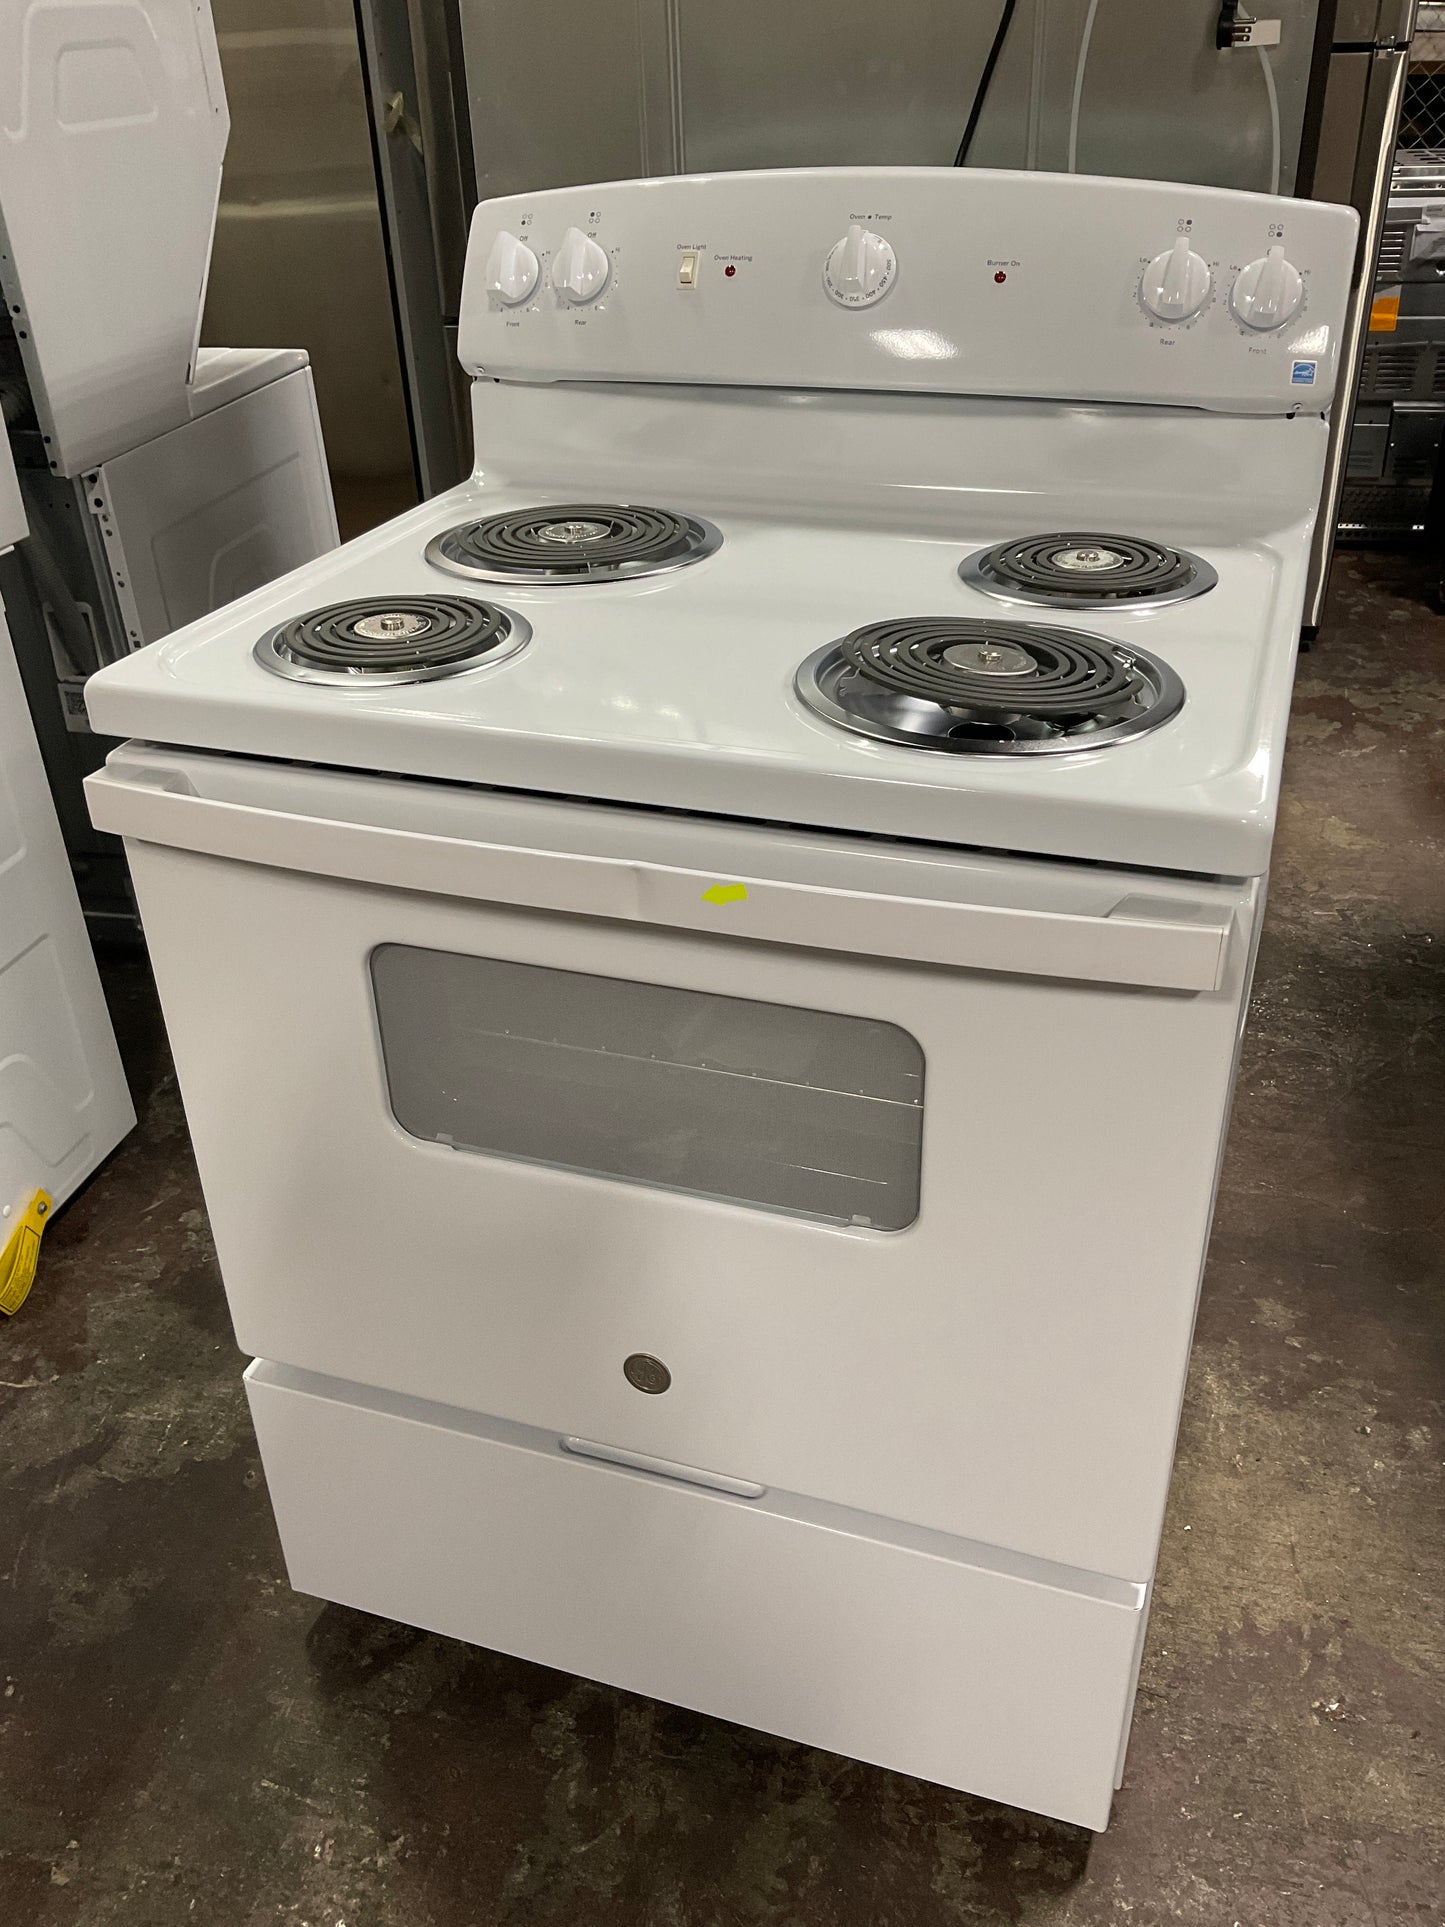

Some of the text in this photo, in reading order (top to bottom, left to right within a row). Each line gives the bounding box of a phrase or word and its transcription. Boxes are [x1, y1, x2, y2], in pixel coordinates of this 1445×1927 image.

[875, 213, 893, 221] Temp
[519, 234, 529, 243] Off
[587, 231, 597, 240] Off
[692, 243, 707, 251] Light
[730, 254, 753, 262] Heating
[506, 320, 520, 328] Front
[574, 319, 587, 327] Rear
[1159, 338, 1175, 346] Rear
[1248, 346, 1267, 355] Front
